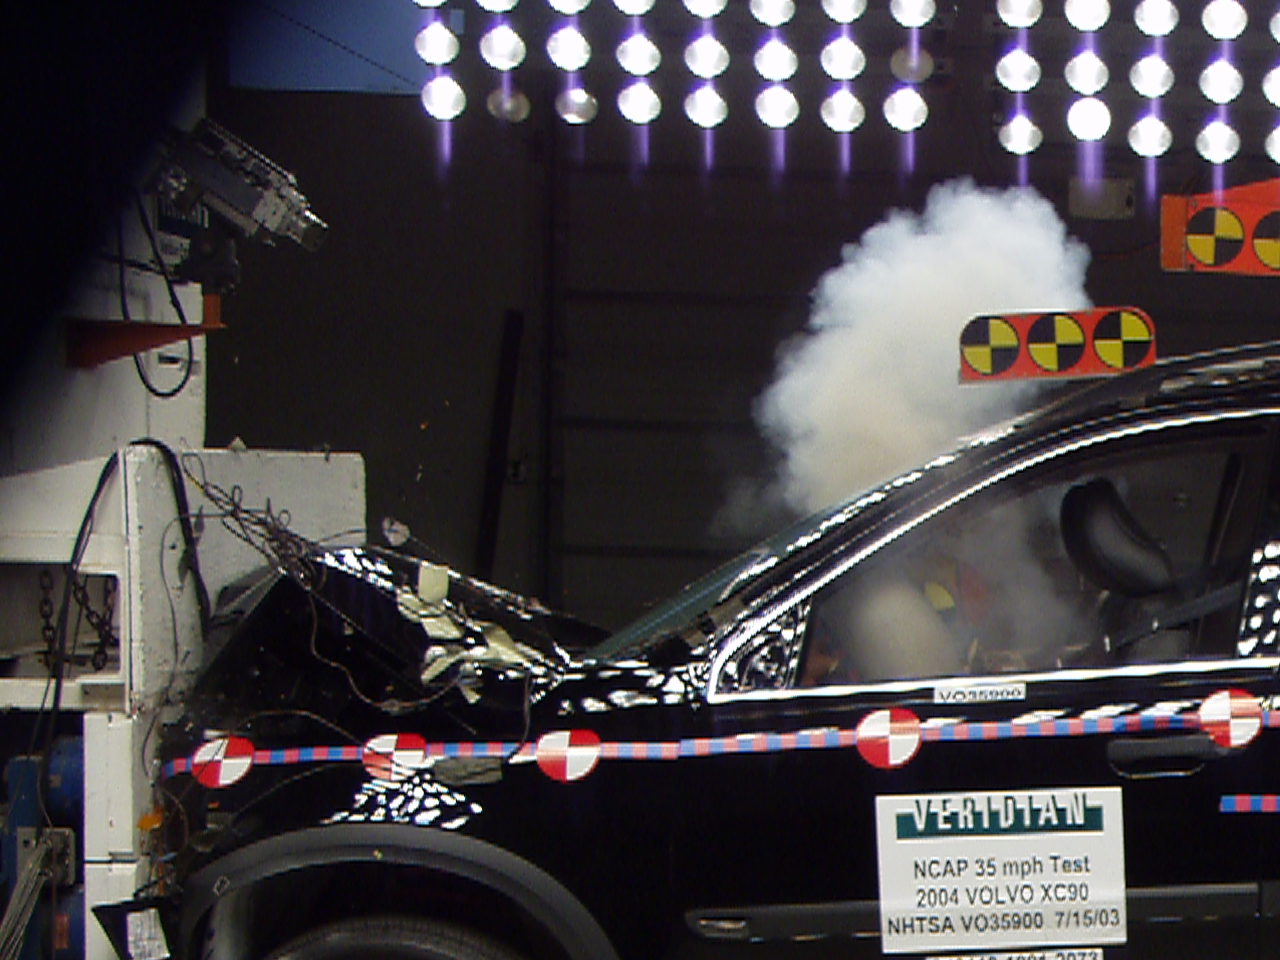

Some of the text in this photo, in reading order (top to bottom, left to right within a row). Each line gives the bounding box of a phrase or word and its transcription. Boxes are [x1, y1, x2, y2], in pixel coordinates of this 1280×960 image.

[912, 793, 1087, 832] VERIDIAN
[914, 854, 1091, 879] NCAP 35 mph Test
[916, 882, 1089, 908] 2004 VOLVO XC90
[888, 908, 1121, 935] NHTSA VO35900 7/15/03
